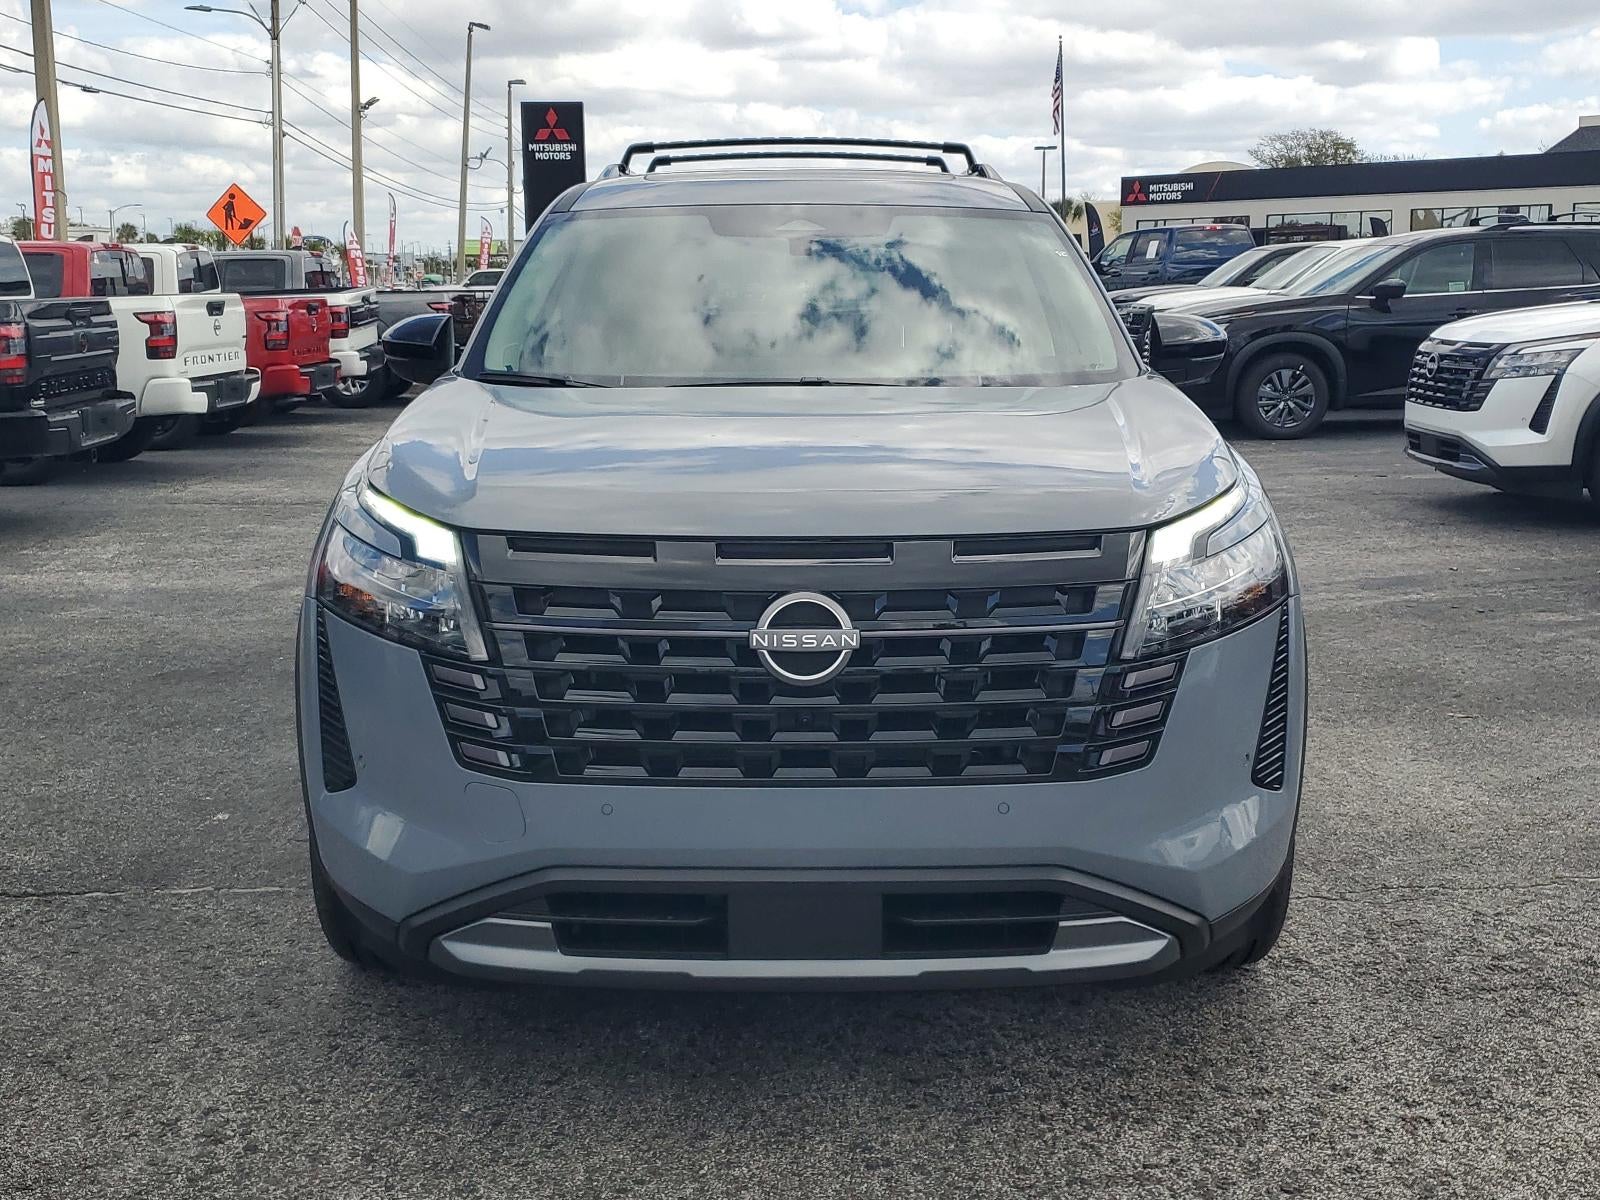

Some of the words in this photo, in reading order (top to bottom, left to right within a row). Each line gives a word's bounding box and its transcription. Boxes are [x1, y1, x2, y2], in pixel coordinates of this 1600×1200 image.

[528, 143, 577, 152] MITSUBISHI
[535, 152, 571, 160] MOTORS
[1149, 182, 1194, 193] MITSUBISHI
[38, 157, 55, 239] MITSU
[1149, 192, 1182, 201] MOTORS
[350, 249, 366, 287] MITS
[183, 351, 240, 366] FRONTIER
[752, 633, 857, 648] NISSAN
